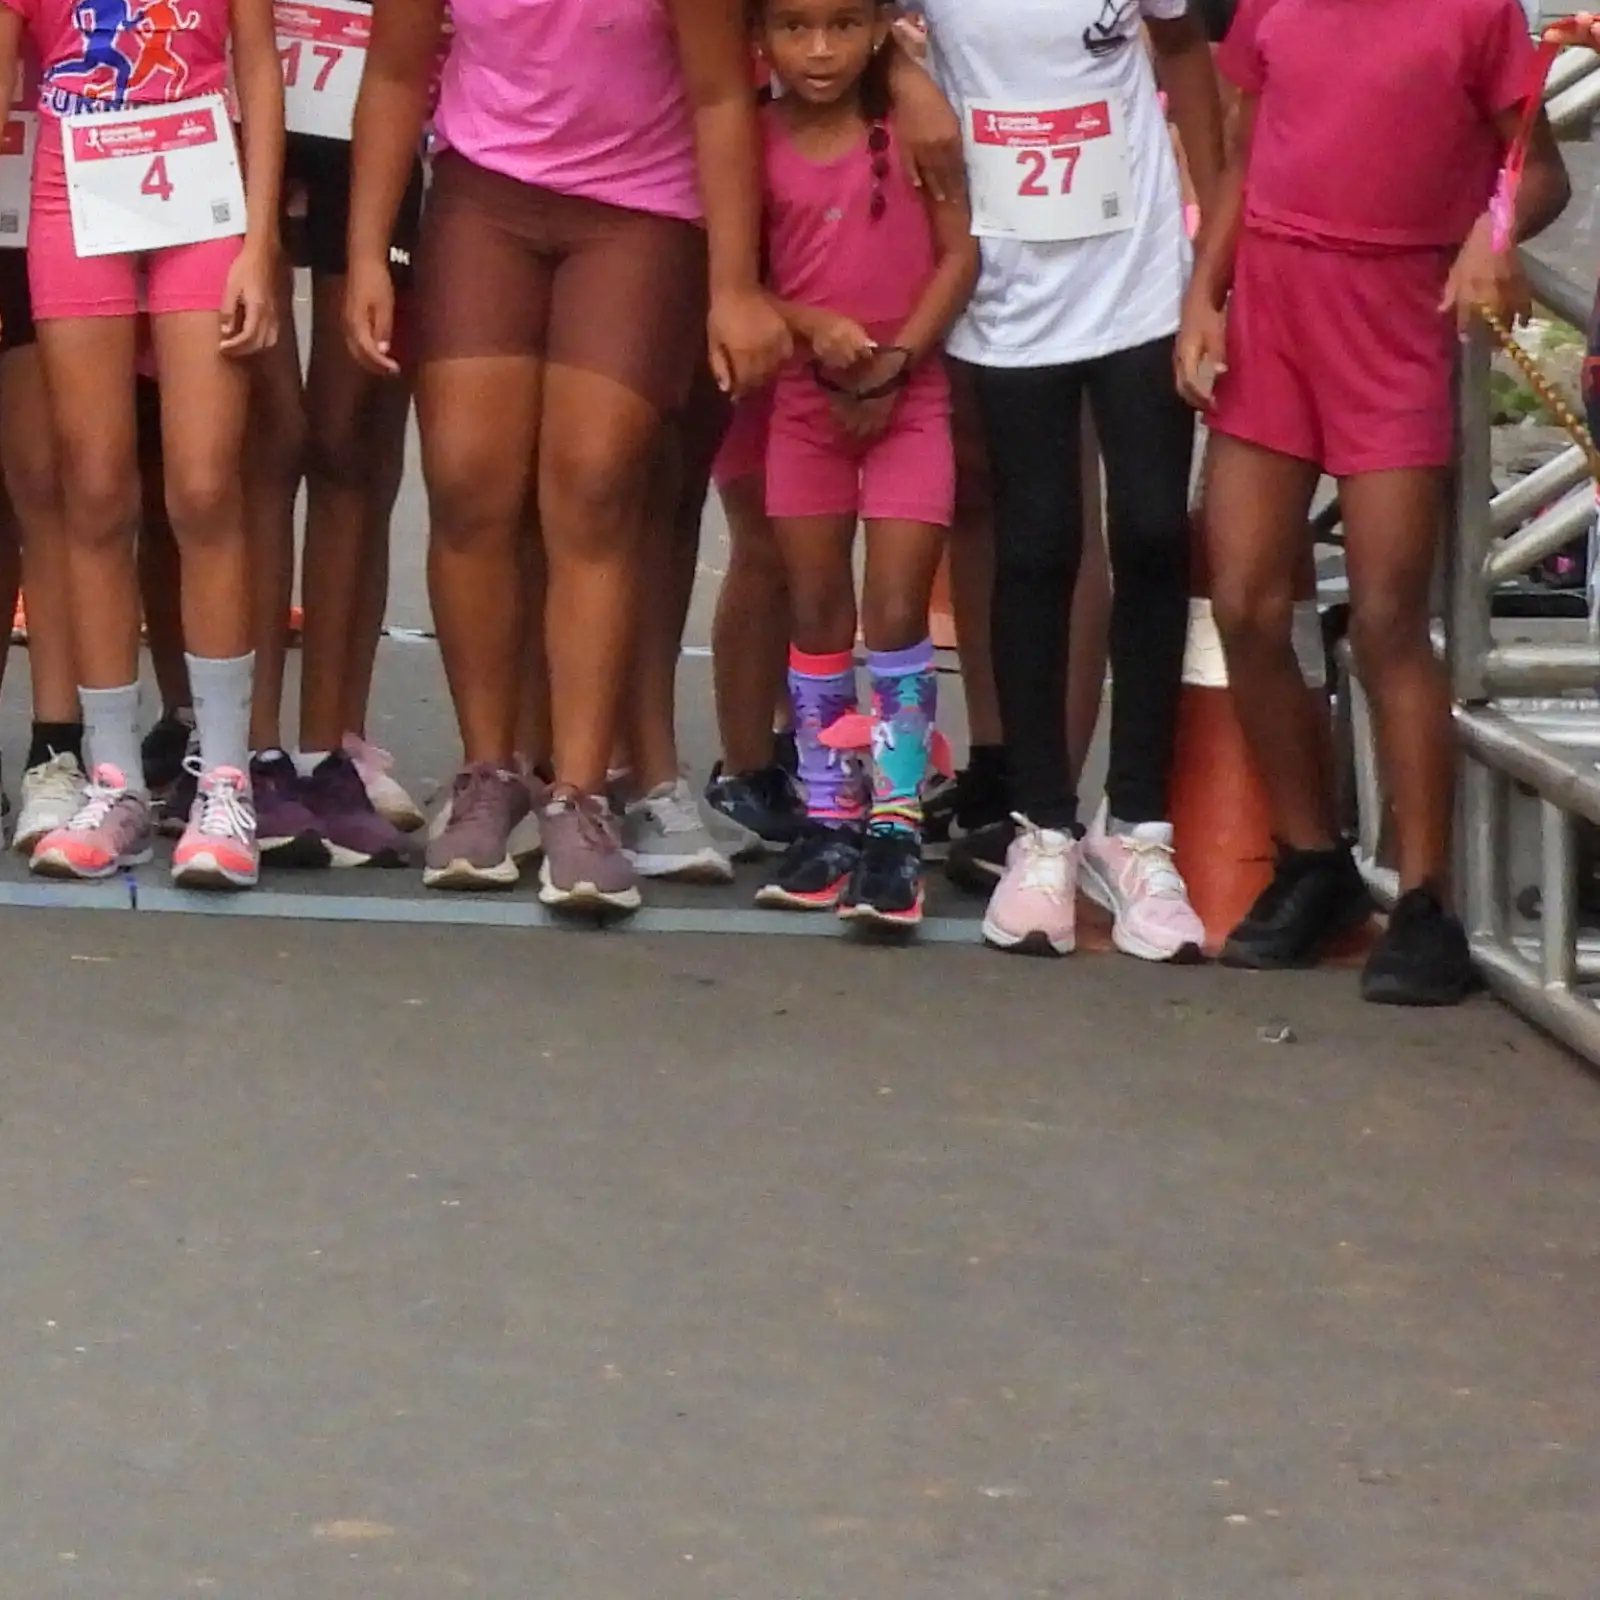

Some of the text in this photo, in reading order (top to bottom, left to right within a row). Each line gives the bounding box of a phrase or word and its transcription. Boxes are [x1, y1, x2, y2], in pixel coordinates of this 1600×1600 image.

[280, 42, 343, 92] 17
[140, 155, 174, 201] 4
[1016, 146, 1080, 196] 27
